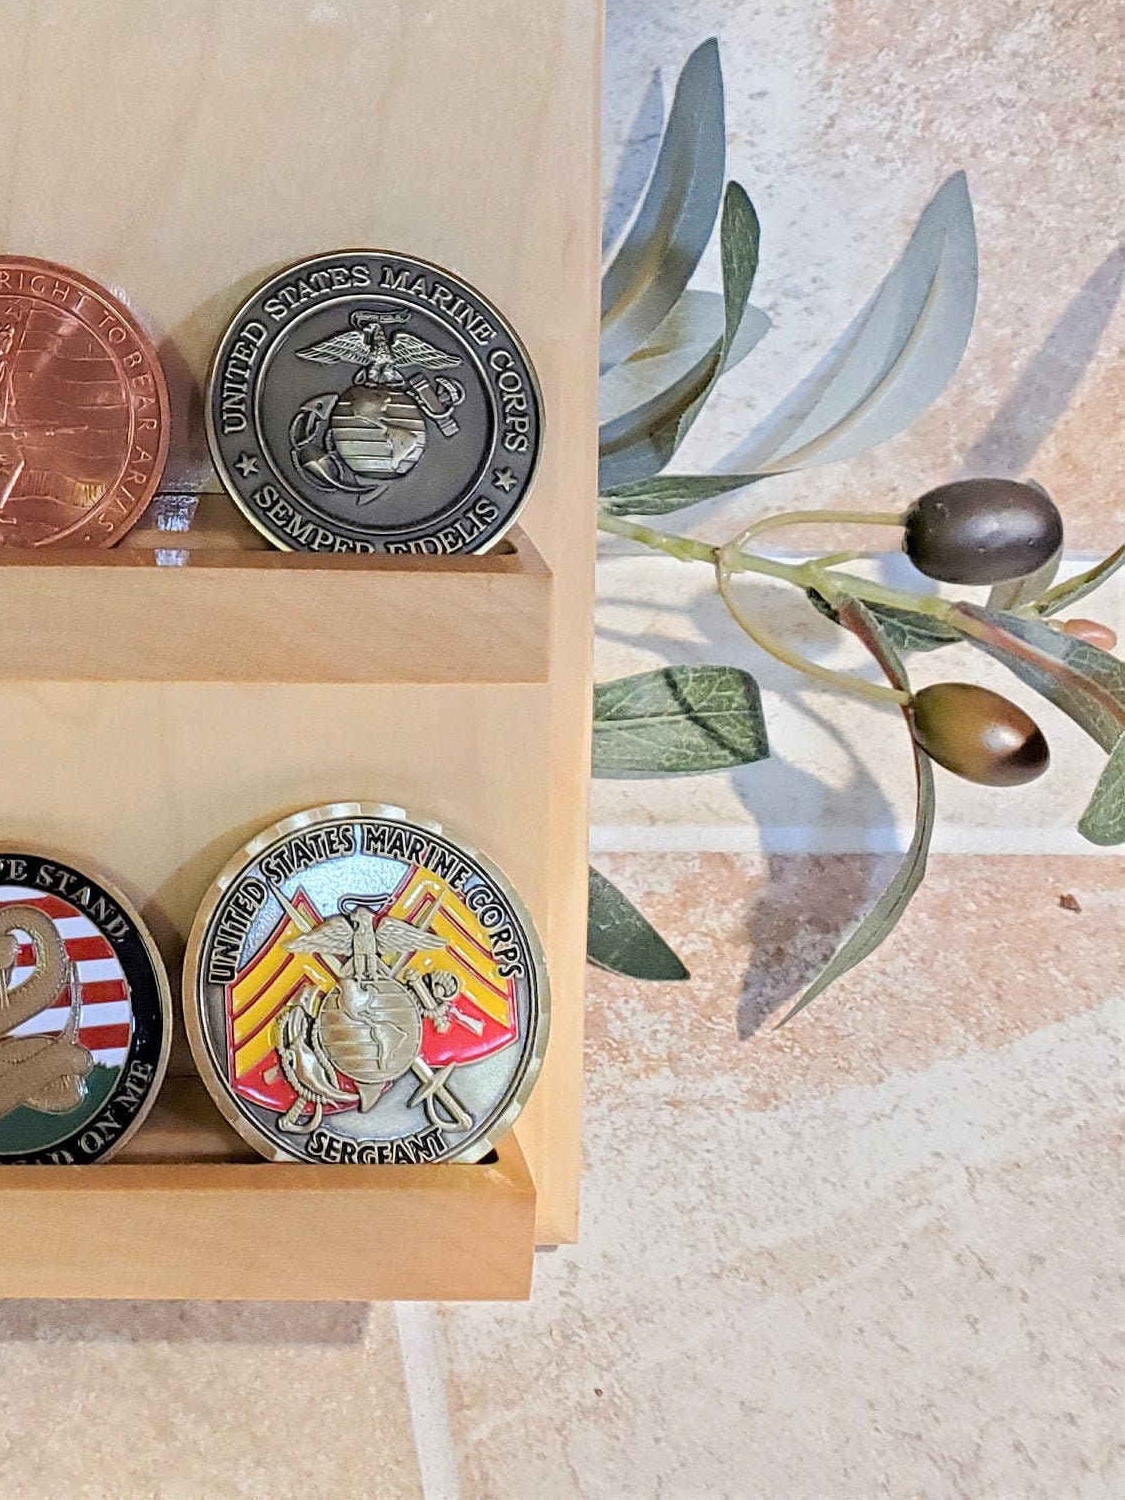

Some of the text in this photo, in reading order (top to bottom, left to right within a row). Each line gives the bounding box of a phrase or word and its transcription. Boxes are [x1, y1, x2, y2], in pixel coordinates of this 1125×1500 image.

[98, 309, 127, 346] TO
[224, 265, 531, 453] UNITED STATES MARINE CORPS
[122, 353, 159, 431] BEAR
[97, 445, 154, 533] ARMS
[34, 864, 130, 943] STAND
[207, 823, 525, 984] UNITED STATES MARINE CORPS
[77, 1106, 123, 1154] ON
[118, 1058, 154, 1113] ME
[307, 1125, 444, 1164] SERGEANT
